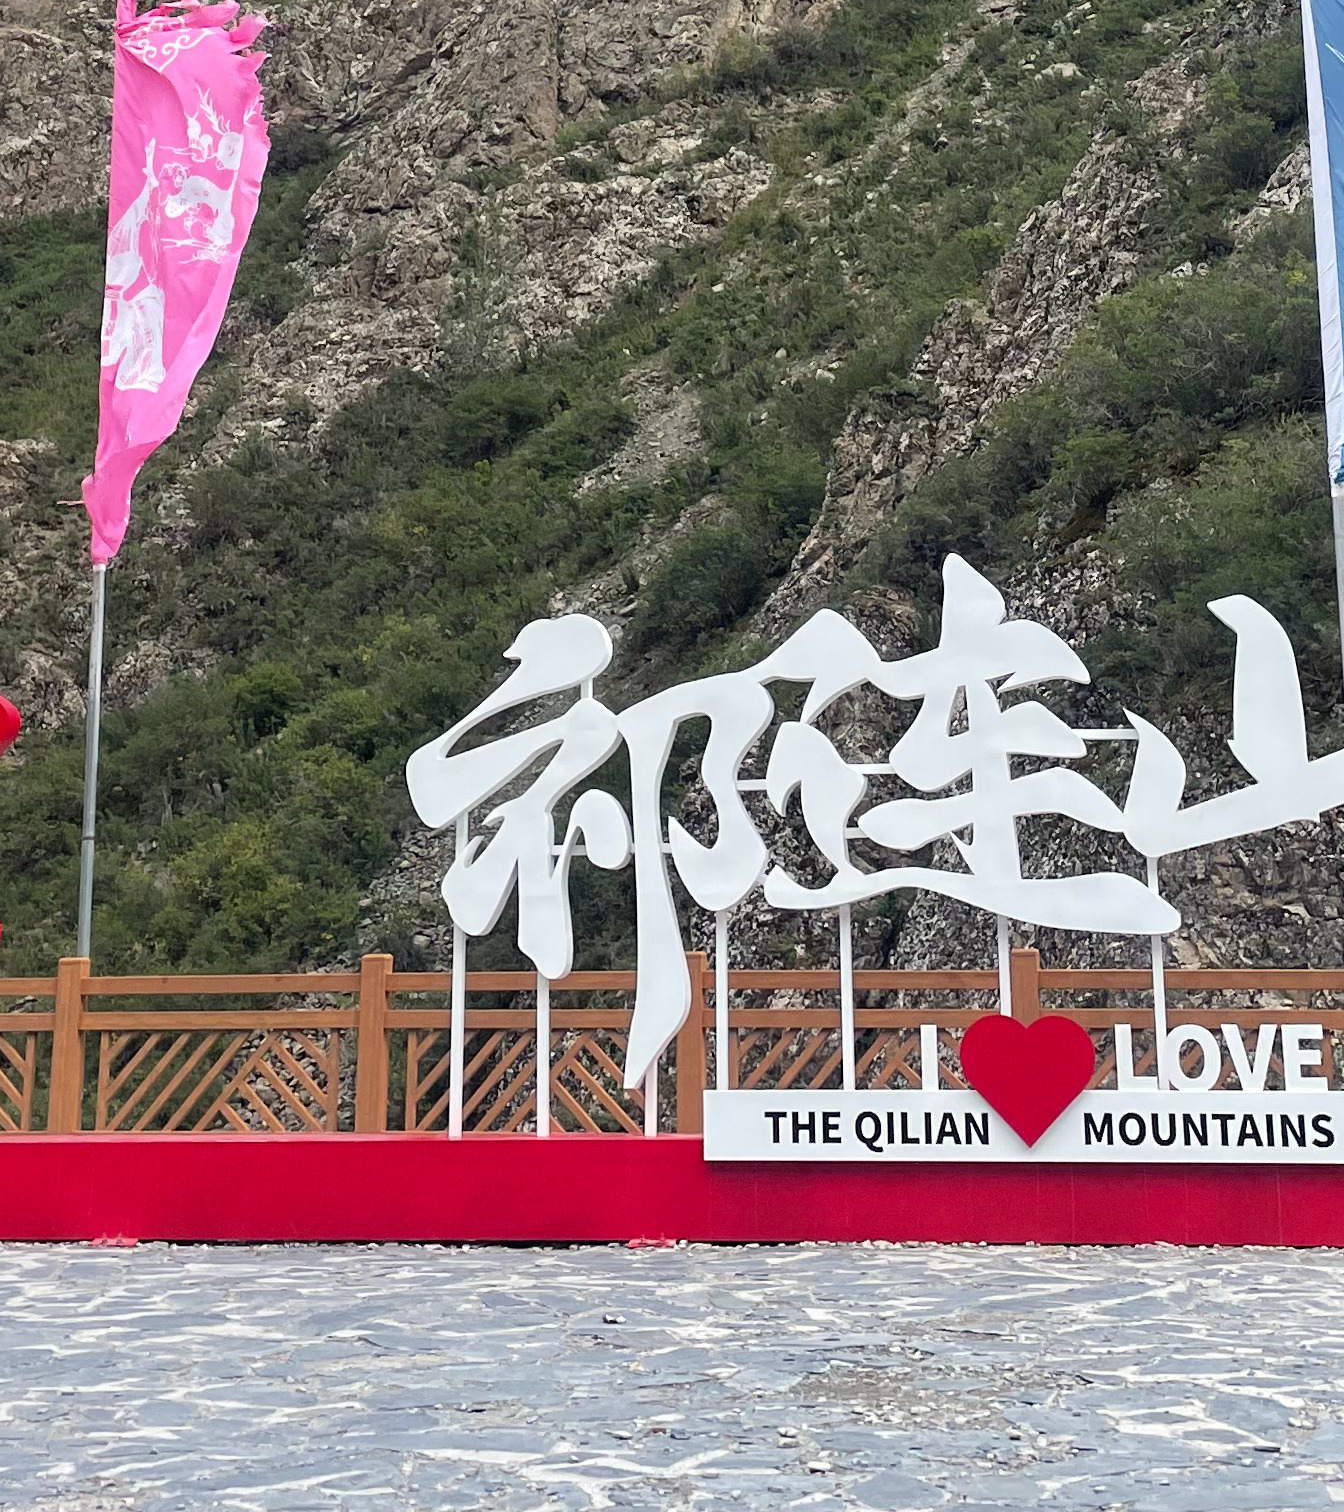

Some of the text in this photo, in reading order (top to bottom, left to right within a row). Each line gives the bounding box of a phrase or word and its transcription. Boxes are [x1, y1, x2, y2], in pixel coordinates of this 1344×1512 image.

[919, 1023, 1330, 1091] I LOVE
[764, 1110, 1336, 1153] THE QILIAN MOUNTAINS
